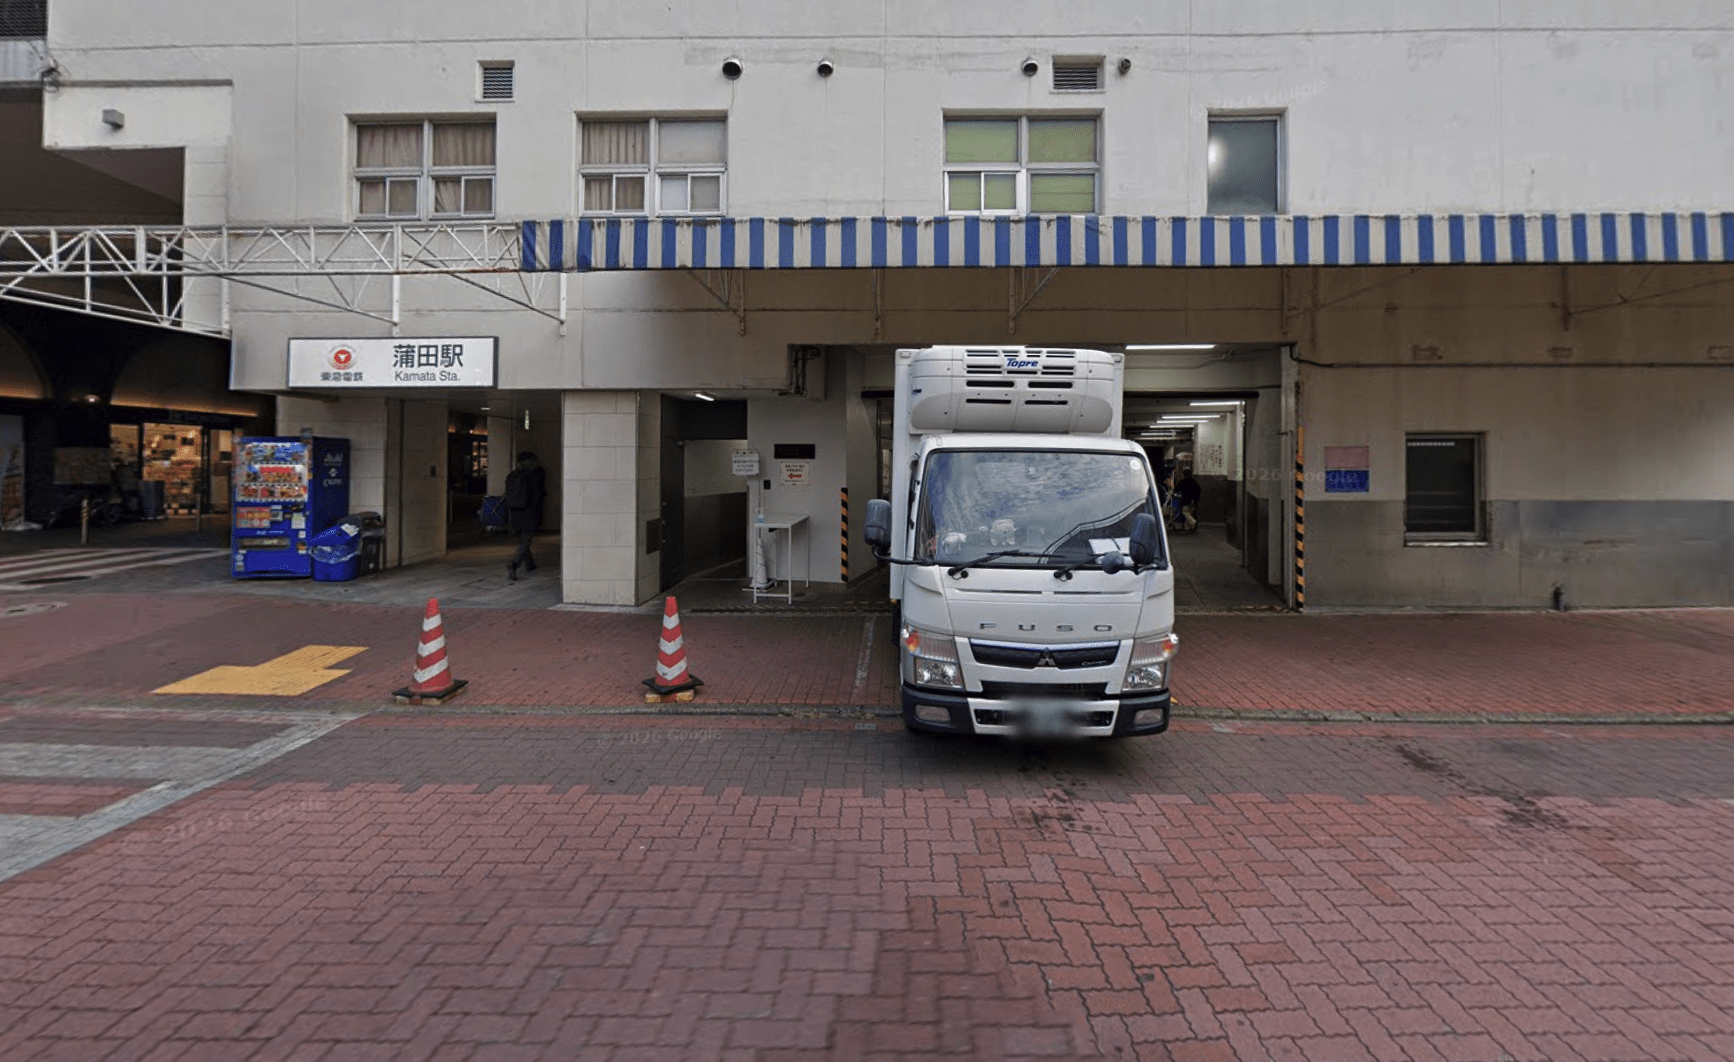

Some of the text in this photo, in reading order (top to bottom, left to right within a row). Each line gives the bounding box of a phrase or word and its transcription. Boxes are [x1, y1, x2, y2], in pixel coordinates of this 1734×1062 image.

[392, 343, 464, 368] 蒲田駅
[1006, 357, 1039, 369] Topre
[394, 370, 461, 382] Kamata Sta.
[979, 622, 1113, 632] FUSO
